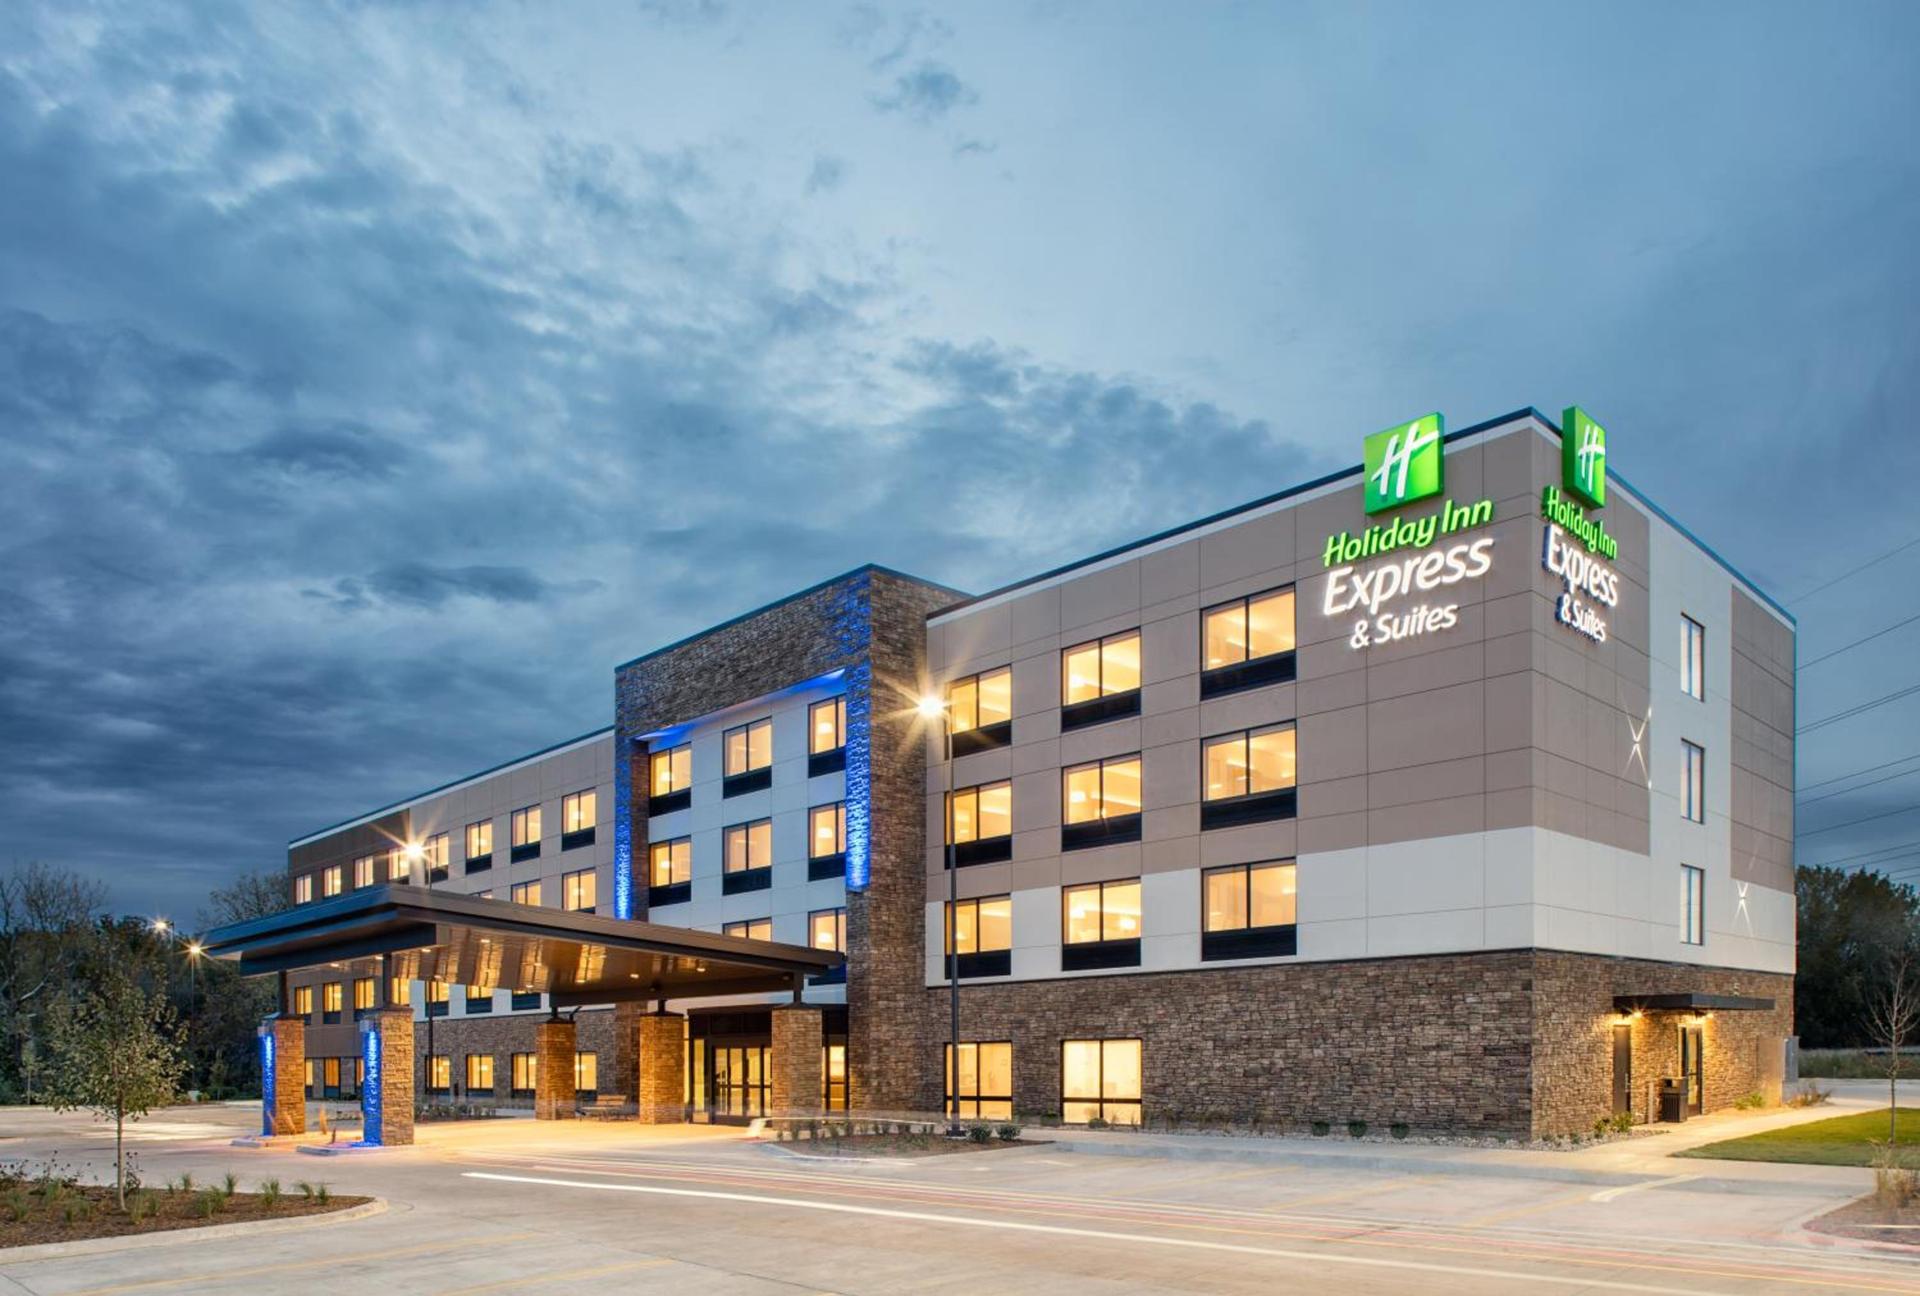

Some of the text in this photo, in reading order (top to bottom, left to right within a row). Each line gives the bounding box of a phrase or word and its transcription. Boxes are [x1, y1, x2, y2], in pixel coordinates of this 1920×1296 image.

[1322, 499, 1493, 567] Holiday Inn
[1546, 485, 1618, 560] Holiday Inn
[1323, 537, 1495, 616] Express
[1547, 523, 1618, 607] Express
[1350, 604, 1459, 649] & Suites
[1560, 593, 1606, 642] & Suites
